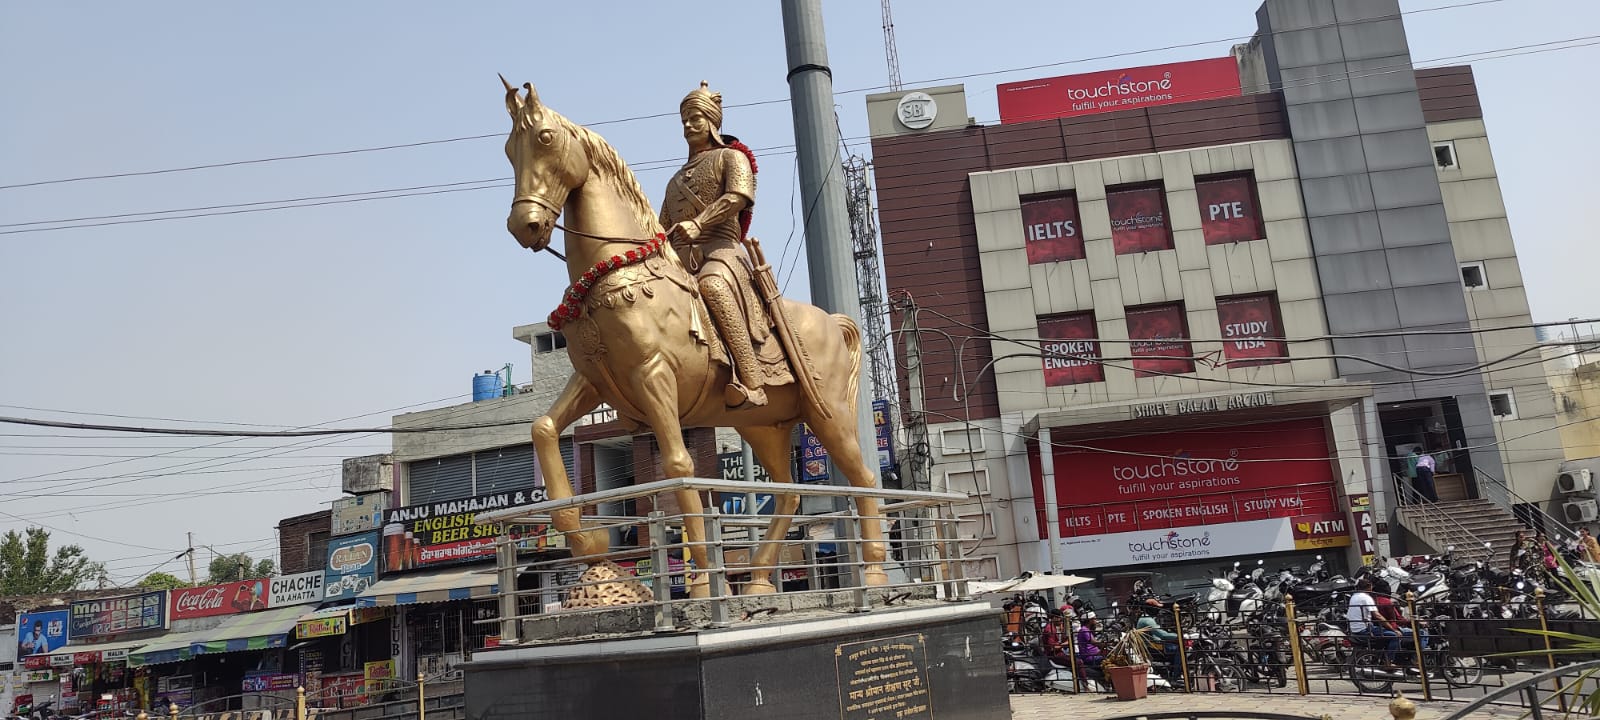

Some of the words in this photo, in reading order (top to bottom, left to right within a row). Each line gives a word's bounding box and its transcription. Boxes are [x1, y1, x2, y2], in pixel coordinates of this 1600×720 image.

[1067, 78, 1172, 101] touchstone
[1072, 101, 1097, 111] fulfill
[1097, 99, 1119, 109] your
[1121, 93, 1173, 105] aspirations
[1111, 213, 1163, 227] touchstone
[1208, 201, 1244, 221] PTE
[1028, 220, 1075, 241] IELTS
[1225, 320, 1268, 337] STUDY
[1044, 341, 1094, 356] SPOKEN
[1129, 334, 1182, 348] touchstone
[1234, 335, 1266, 350] VISA
[1044, 353, 1097, 370] ENGLISH
[1135, 403, 1170, 418] SHREE
[1177, 398, 1219, 414] BALAJI
[1228, 392, 1273, 409] ARCADE
[1113, 456, 1239, 481] touchstone
[1118, 482, 1147, 495] fulfill
[1150, 481, 1175, 494] your
[1178, 474, 1240, 490] aspirations
[390, 505, 429, 523] ANJU
[434, 493, 509, 515] MAHAJAN
[514, 492, 525, 504] &
[1065, 515, 1092, 528] IELTS
[1107, 512, 1126, 524] PTE
[1143, 507, 1183, 522] SPOKEN
[1185, 503, 1229, 518] ENGLISH
[1243, 498, 1276, 512] STUDY
[1279, 495, 1304, 509] VISA
[413, 513, 475, 533] ENGLISH
[1313, 519, 1345, 534] ATM
[431, 526, 470, 544] BEER
[1128, 537, 1211, 553] touchstone
[1132, 553, 1150, 561] fulfill
[1152, 552, 1168, 561] your
[1170, 549, 1210, 559] aspirations
[271, 574, 322, 594] CHACHE
[275, 595, 285, 604] DA
[286, 591, 316, 602] AHATTA
[73, 600, 127, 614] MALIK
